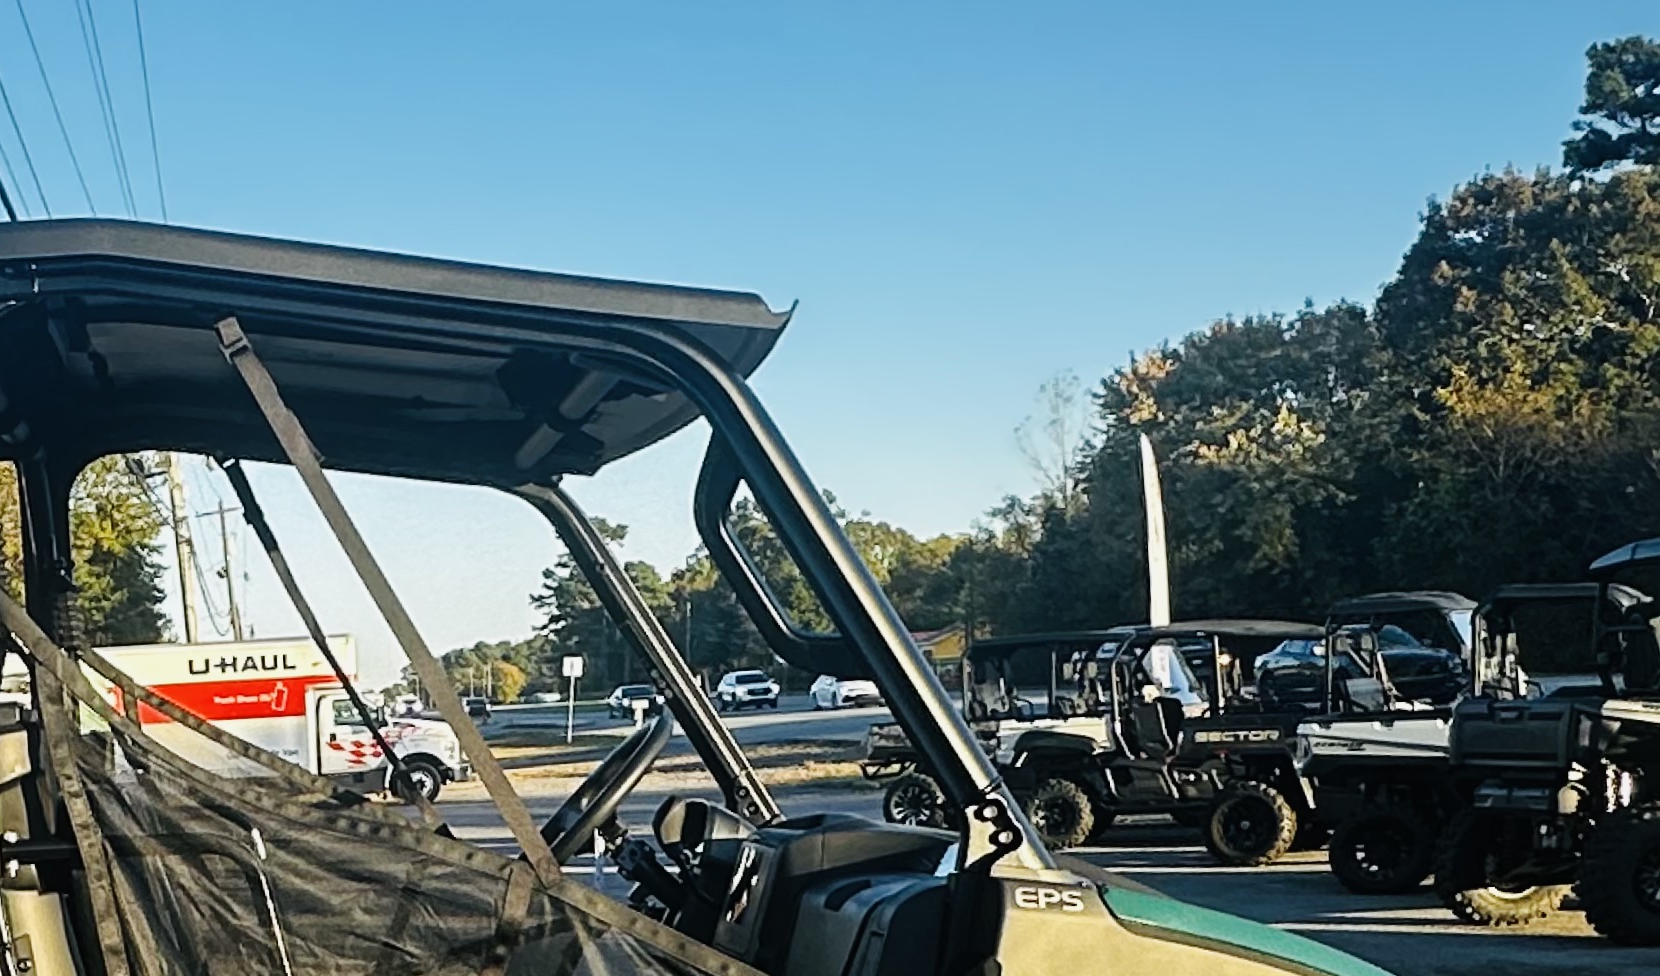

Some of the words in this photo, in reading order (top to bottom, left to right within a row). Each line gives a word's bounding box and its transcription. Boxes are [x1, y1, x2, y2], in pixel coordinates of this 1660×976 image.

[189, 655, 297, 675] U-HAUL
[1194, 730, 1280, 743] SECTOR
[1014, 887, 1084, 912] EPS
